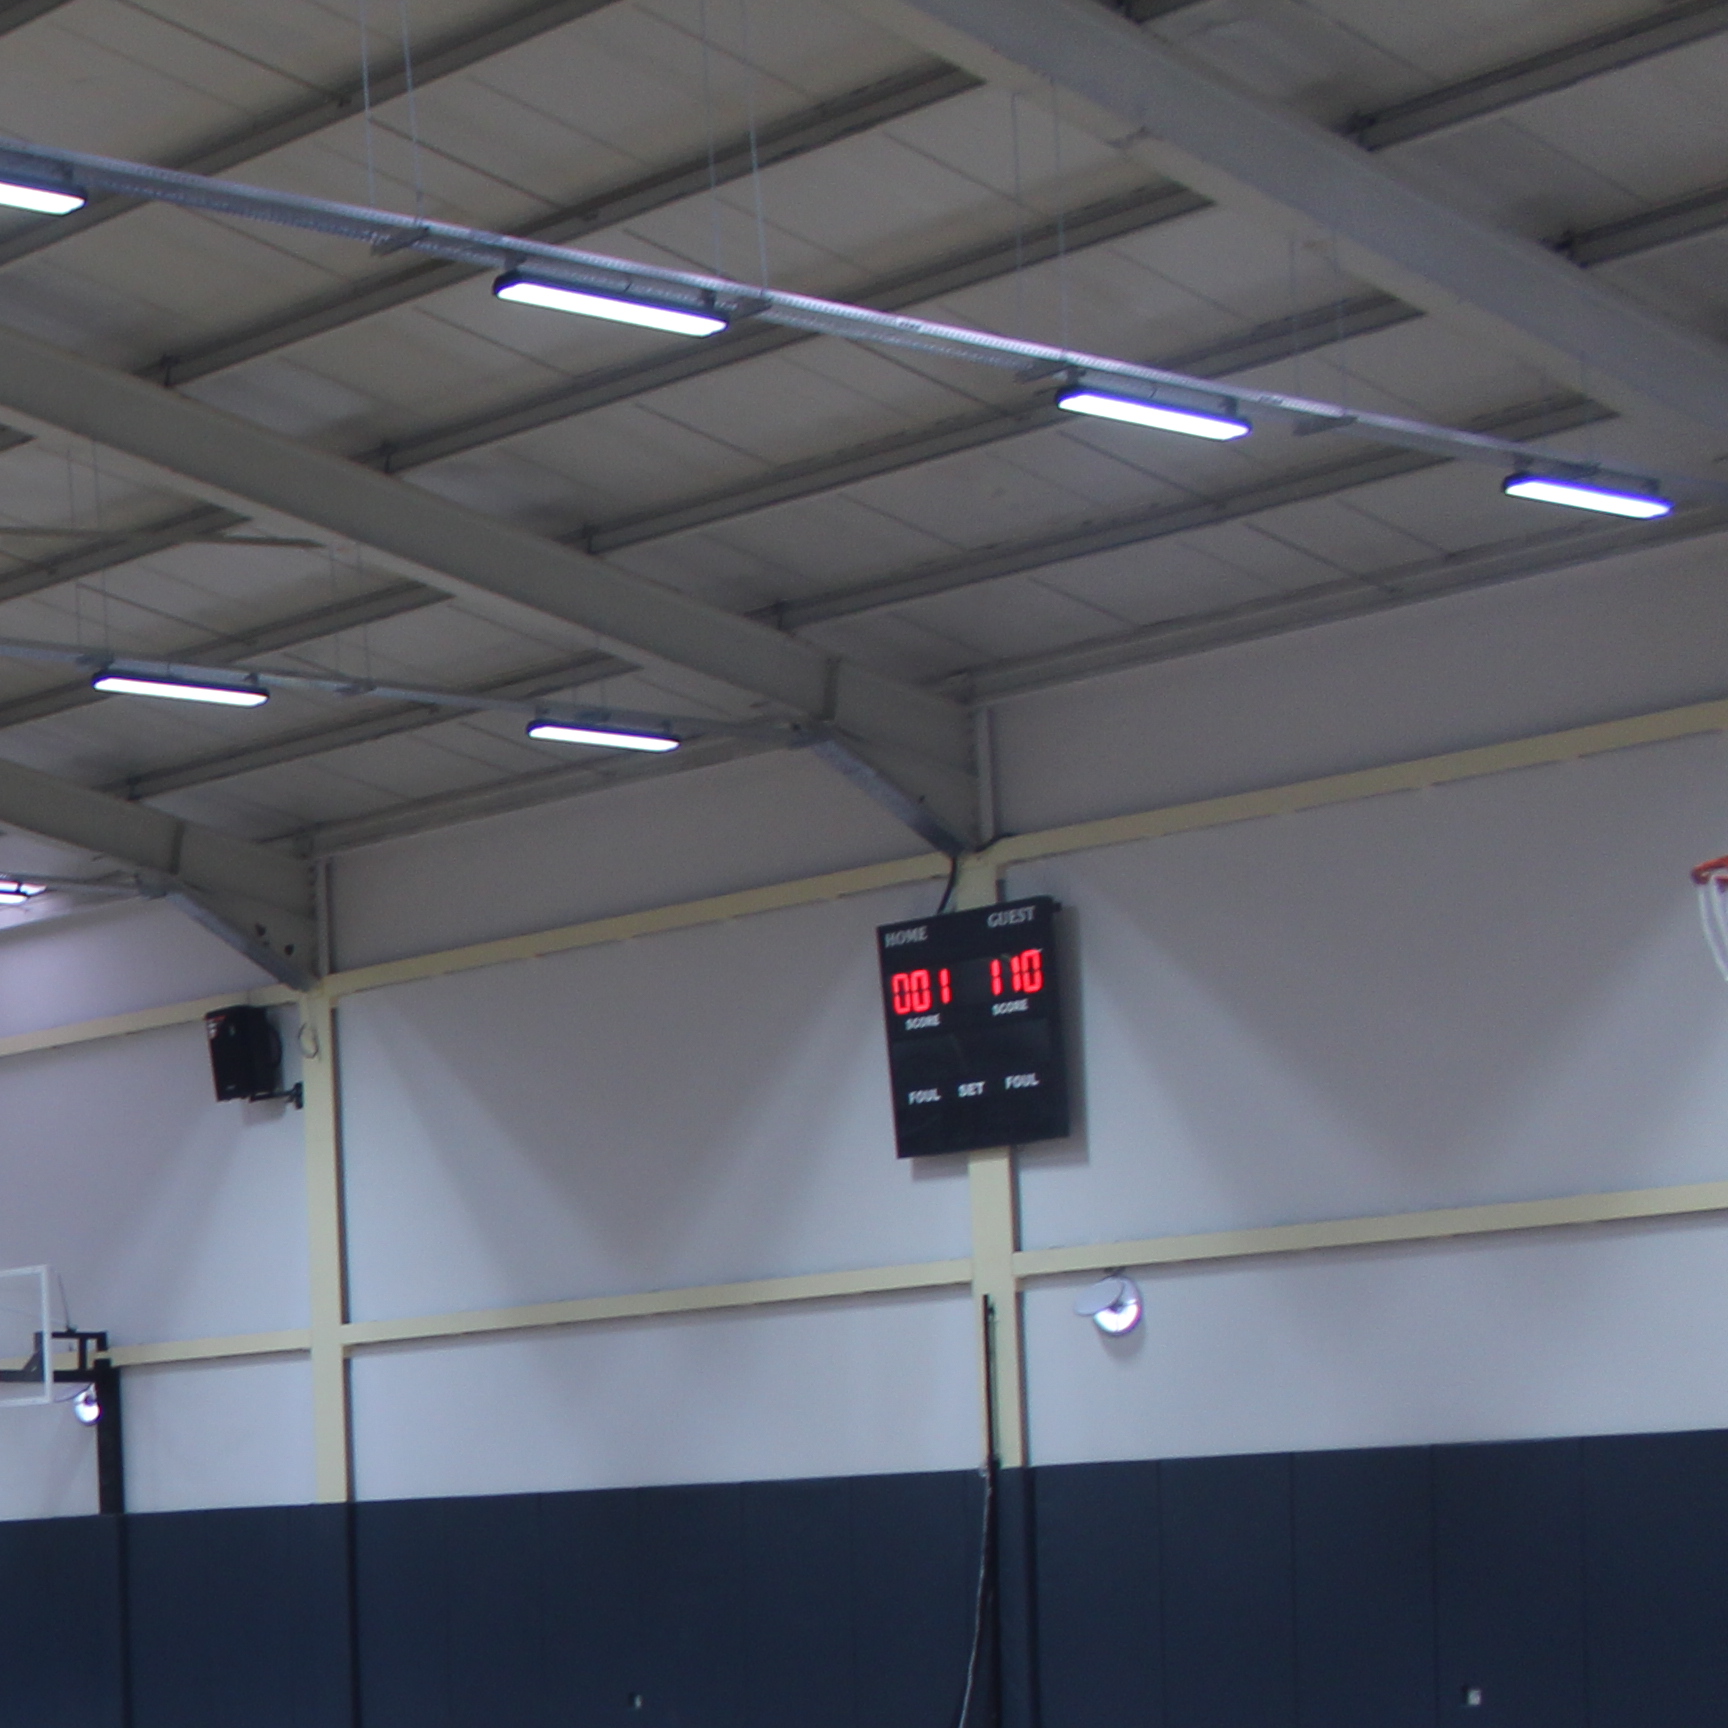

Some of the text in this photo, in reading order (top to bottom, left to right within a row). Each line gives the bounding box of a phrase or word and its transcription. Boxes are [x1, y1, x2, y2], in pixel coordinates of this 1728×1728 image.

[988, 907, 1035, 927] GUEST
[885, 927, 928, 947] HOME
[992, 998, 1028, 1016] SCORE
[905, 1014, 941, 1031] SCORE
[958, 1081, 985, 1098] SET
[1005, 1073, 1040, 1090] FOUL
[908, 1088, 941, 1105] FOUL
